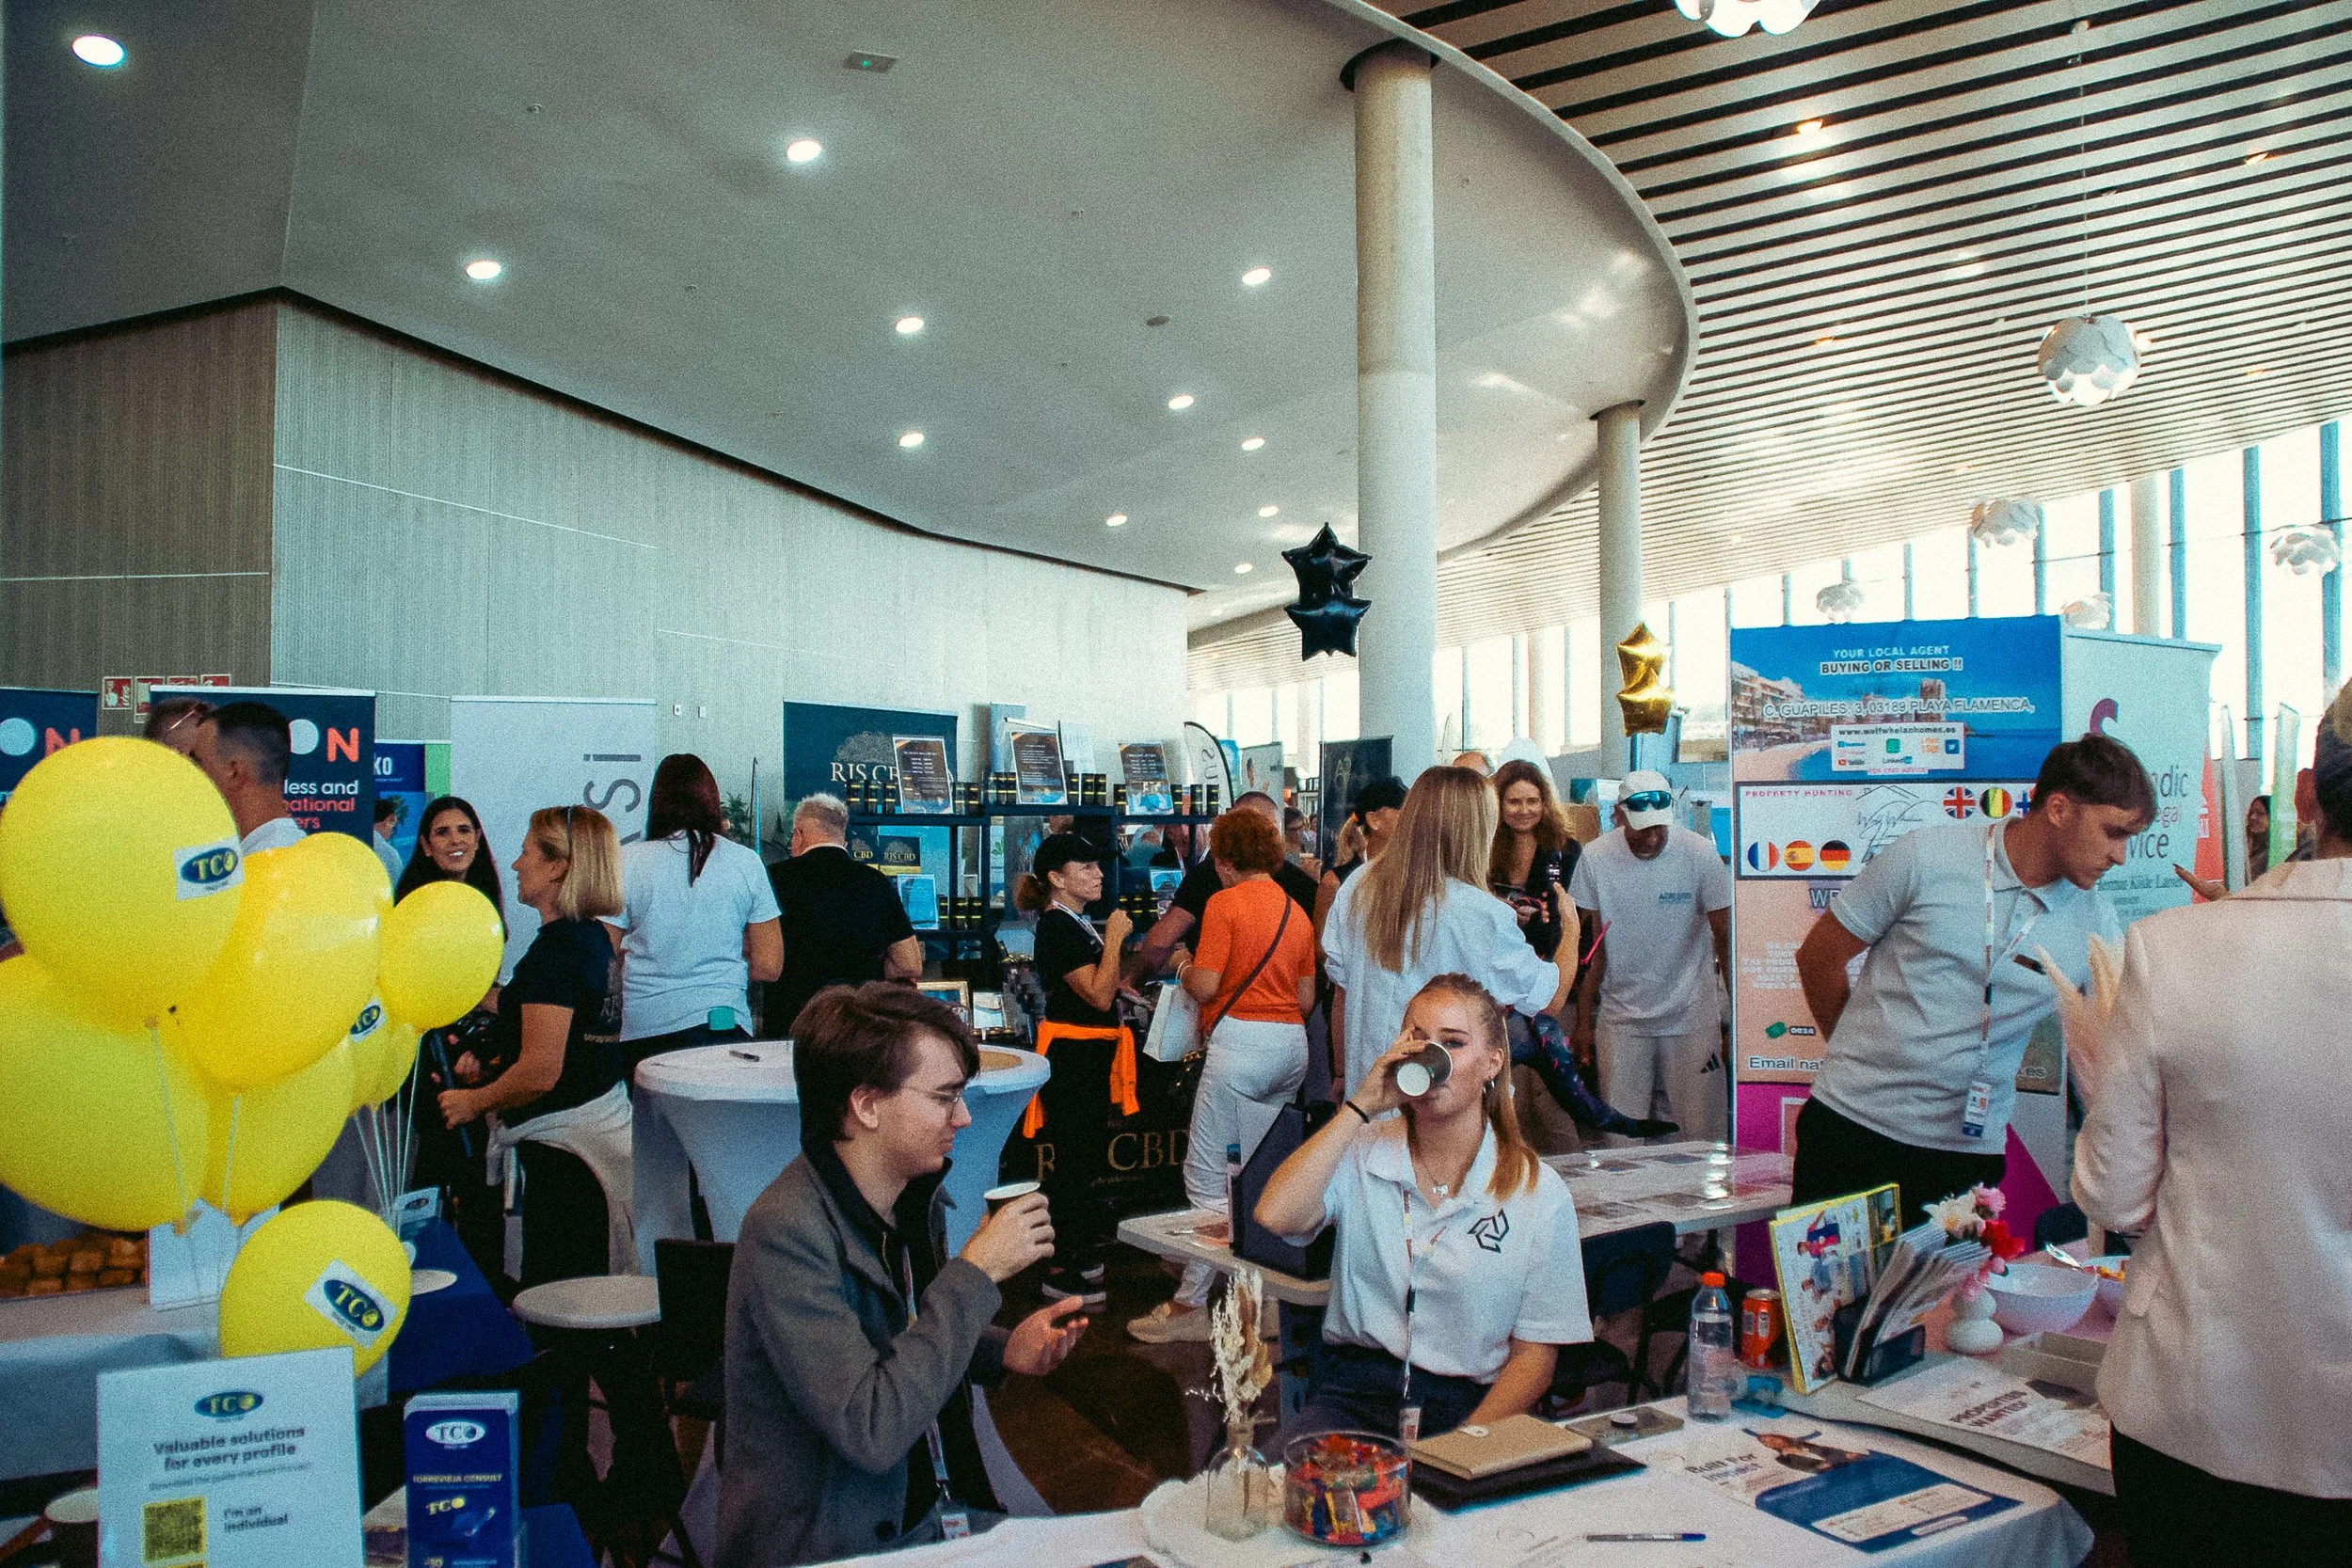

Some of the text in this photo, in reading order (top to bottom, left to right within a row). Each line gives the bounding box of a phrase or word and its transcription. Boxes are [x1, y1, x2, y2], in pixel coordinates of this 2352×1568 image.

[1834, 645, 1949, 658] YOUR LOCAL AGENT
[1821, 661, 1870, 674] BUYING
[1874, 660, 1891, 672] OR
[1896, 658, 1949, 671] SELLING
[1911, 700, 1952, 712] PLAYA
[284, 779, 358, 795] less and
[2128, 833, 2169, 859] vice
[853, 850, 873, 859] CBD
[898, 852, 915, 862] CBD
[192, 851, 235, 880] TCO
[1749, 1056, 1794, 1069] Email
[334, 1284, 379, 1327] TCO
[207, 1392, 256, 1415] TCO
[153, 1426, 306, 1455] Valuable solutions
[436, 1425, 478, 1441] TCO
[164, 1457, 188, 1471] for
[192, 1451, 240, 1468] every
[242, 1443, 297, 1466] profile
[224, 1514, 288, 1533] individual
